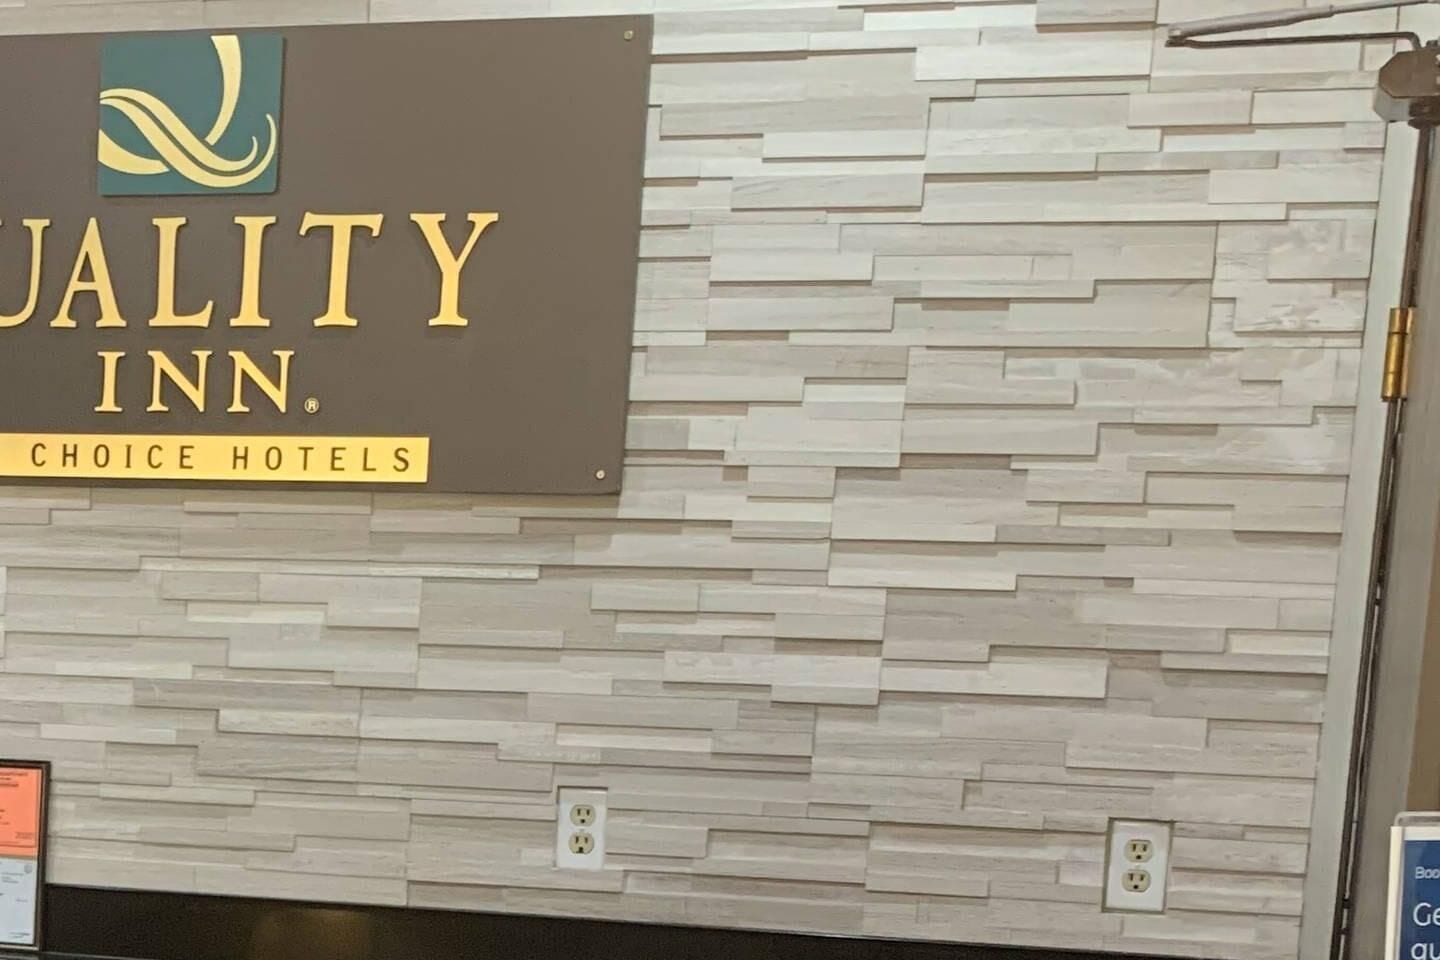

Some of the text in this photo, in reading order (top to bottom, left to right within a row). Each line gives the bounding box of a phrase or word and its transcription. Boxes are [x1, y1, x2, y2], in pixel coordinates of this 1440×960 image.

[95, 349, 294, 413] INN
[31, 443, 195, 470] CHOICE
[231, 445, 411, 472] HOTELS
